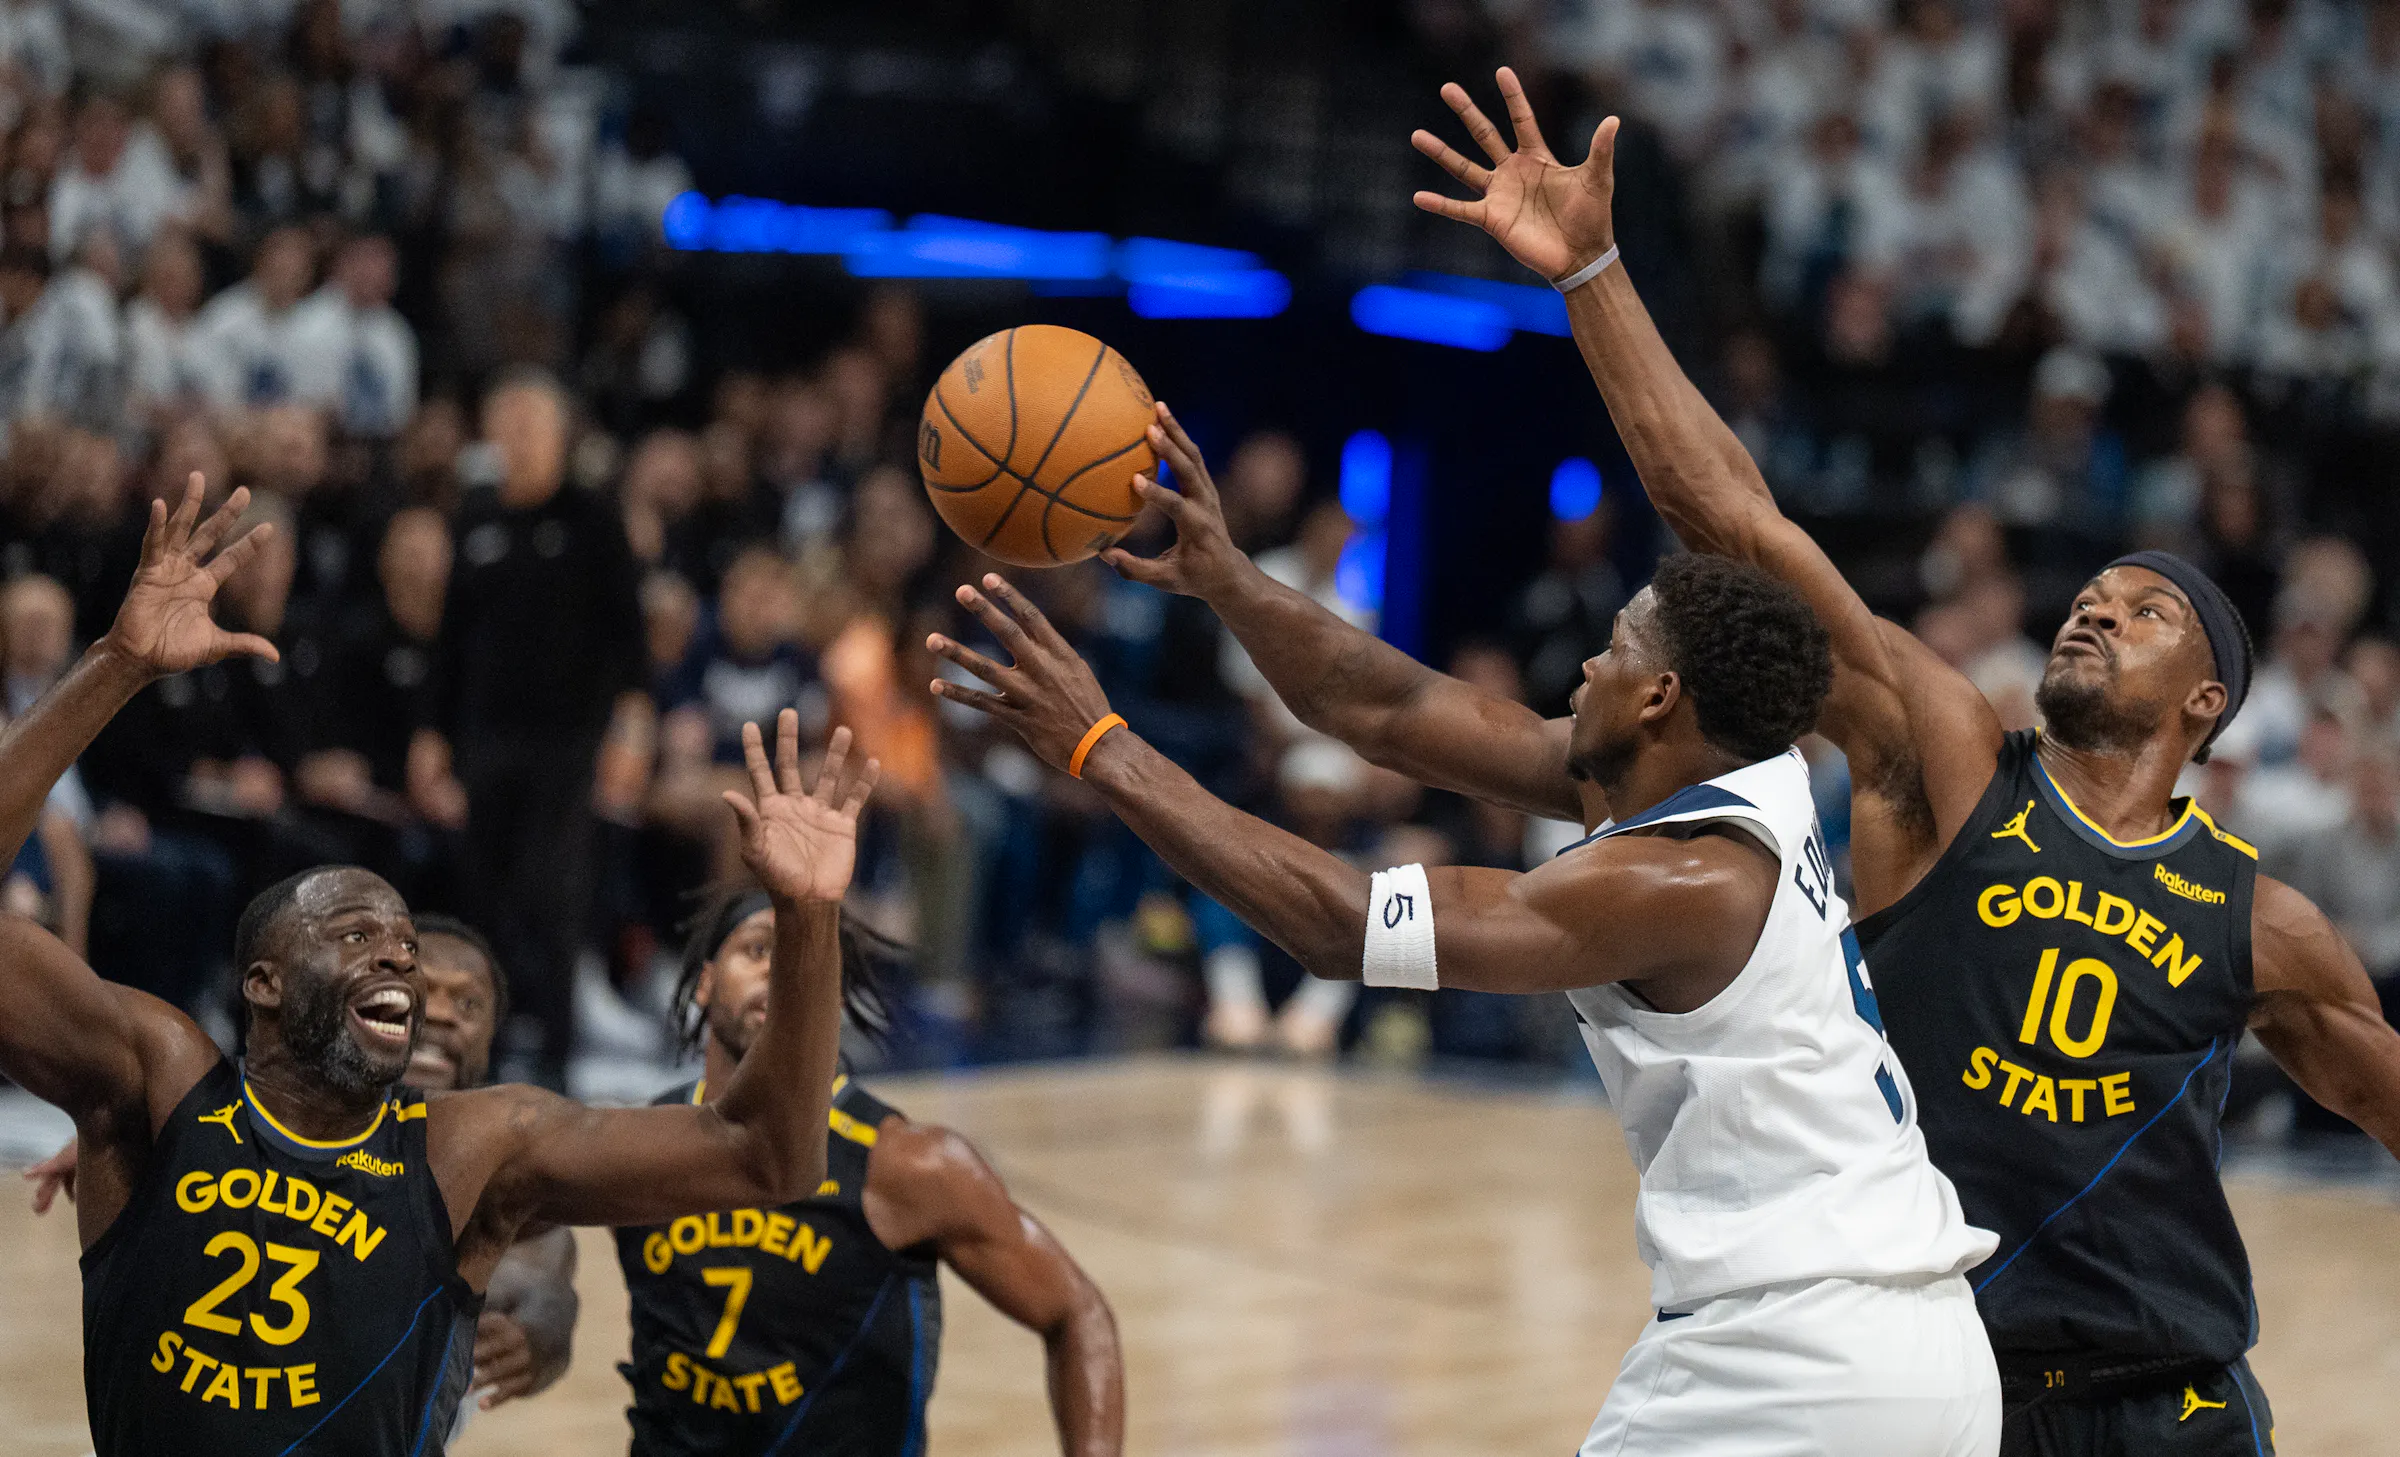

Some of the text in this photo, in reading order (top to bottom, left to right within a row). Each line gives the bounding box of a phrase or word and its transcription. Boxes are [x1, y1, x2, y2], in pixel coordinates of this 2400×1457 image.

[1383, 893, 1413, 929] 5
[2154, 864, 2226, 905] Rakuten
[1977, 876, 2203, 988] GOLDEN
[2018, 948, 2118, 1058] 10
[1962, 1047, 2135, 1123] STATE
[335, 1148, 404, 1177] Rakuten
[176, 1169, 387, 1262] GOLDEN
[643, 1208, 832, 1275] GOLDEN
[183, 1231, 320, 1346] 23
[702, 1267, 753, 1359] 7
[151, 1331, 321, 1410] STATE
[662, 1352, 803, 1414] STATE
